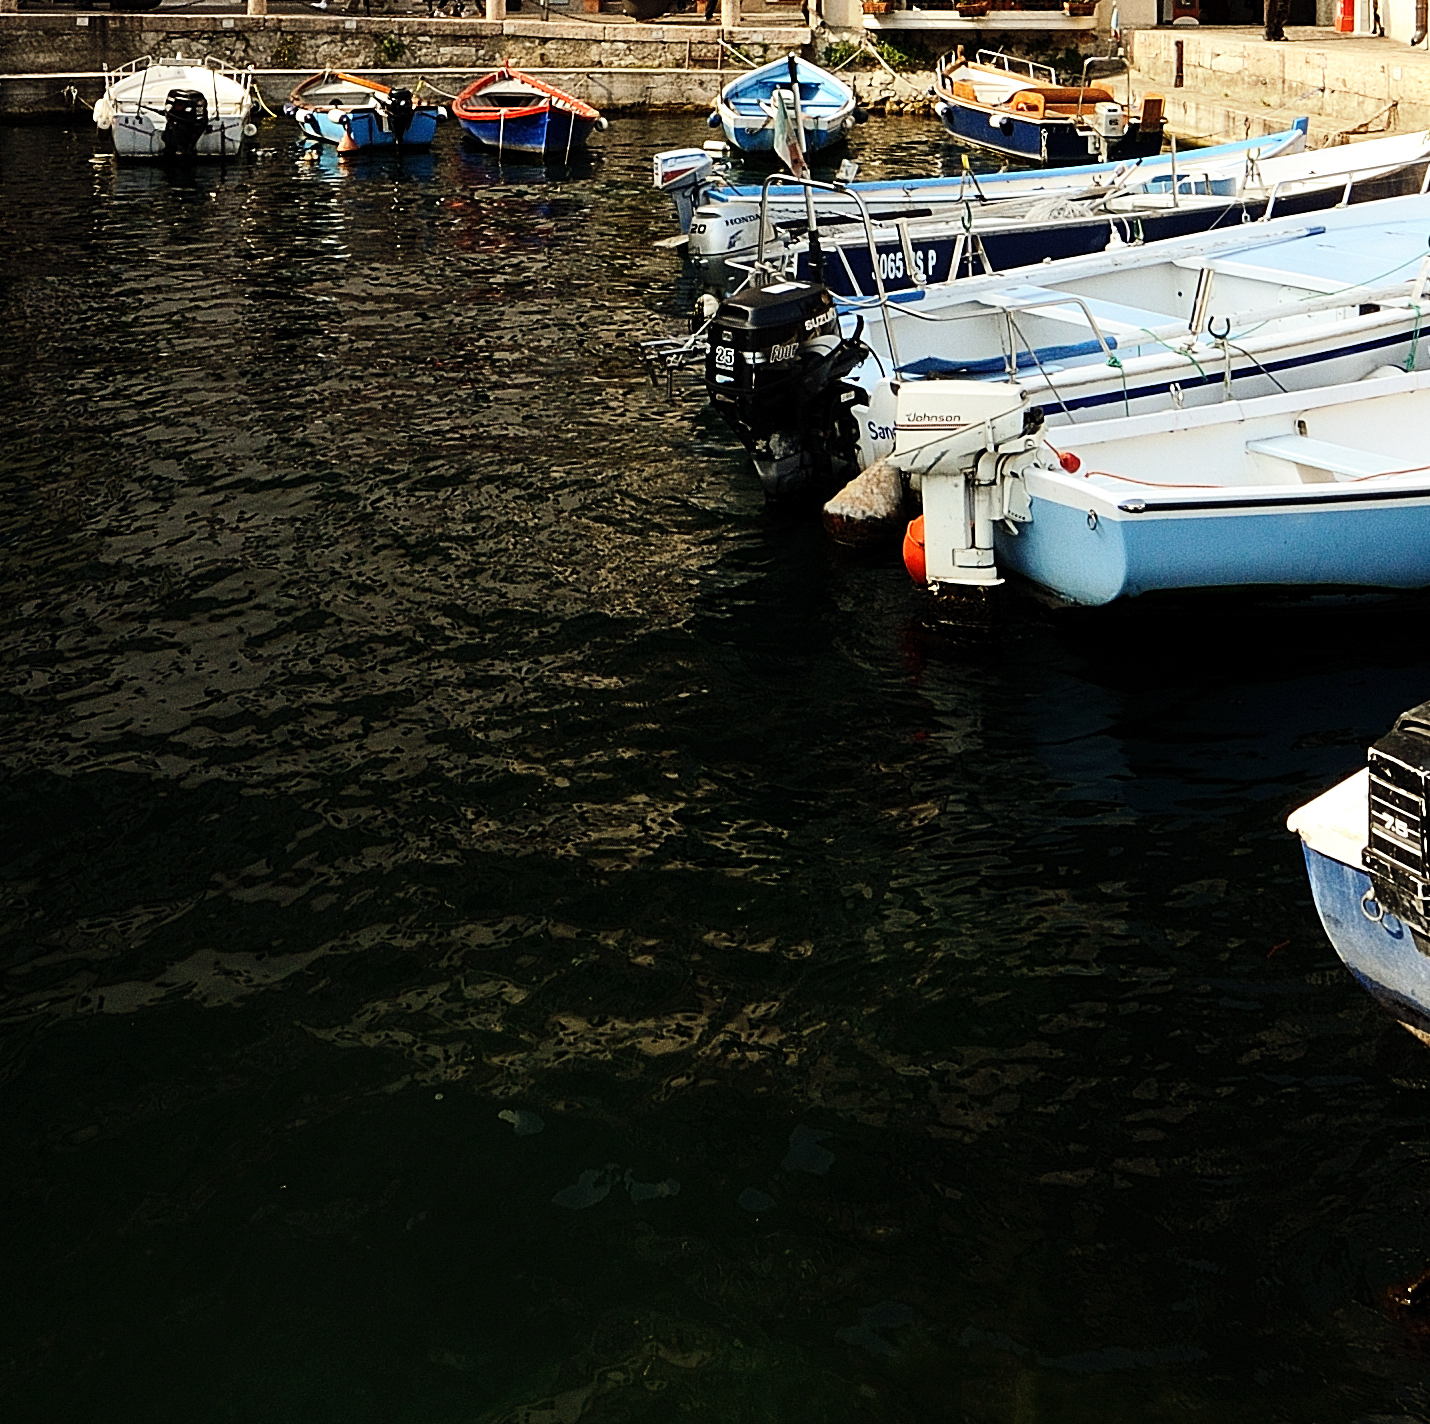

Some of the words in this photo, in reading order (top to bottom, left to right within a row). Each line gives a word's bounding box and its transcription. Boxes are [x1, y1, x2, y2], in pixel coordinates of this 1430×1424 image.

[725, 213, 762, 226] HONDA
[691, 223, 706, 234] 20
[715, 345, 735, 365] 25
[905, 412, 961, 422] Johnson
